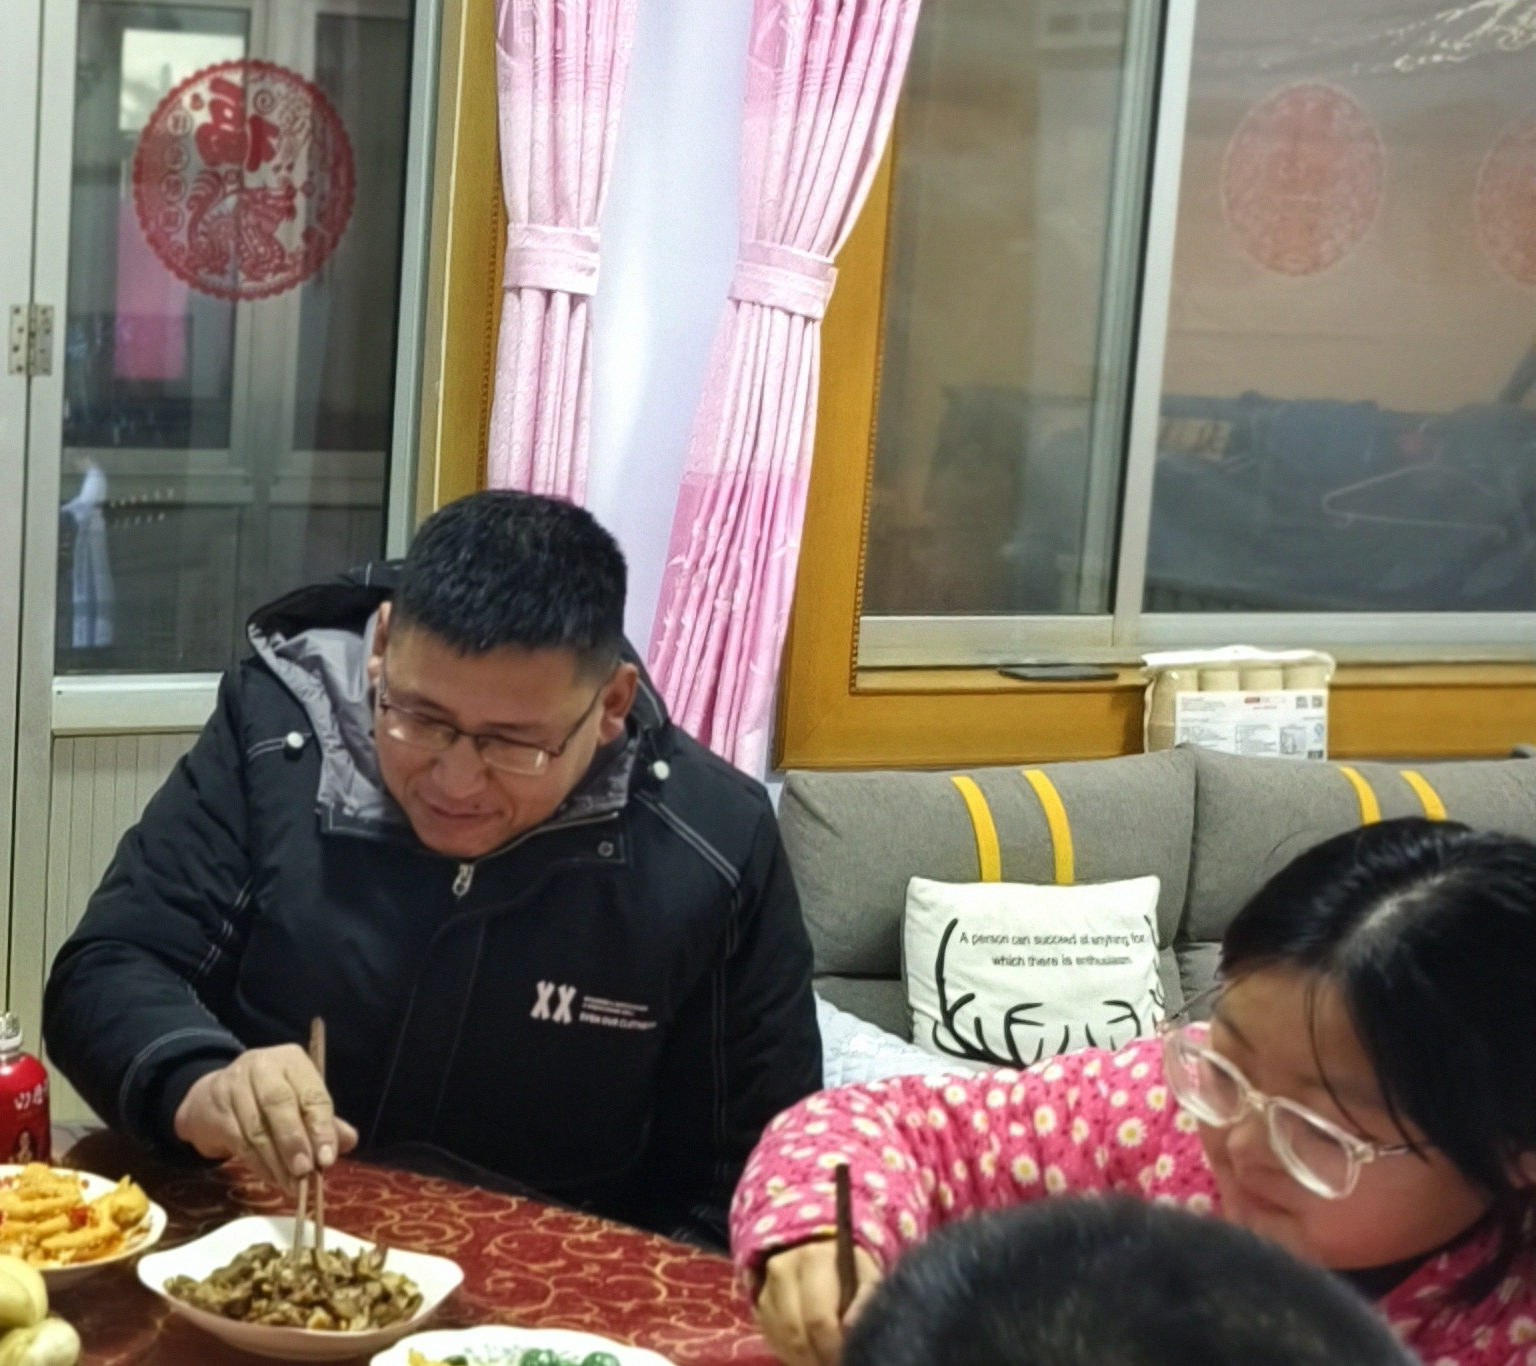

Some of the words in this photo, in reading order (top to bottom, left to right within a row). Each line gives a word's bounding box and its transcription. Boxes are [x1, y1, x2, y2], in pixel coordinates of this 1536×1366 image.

[959, 932, 969, 944] A
[972, 934, 1009, 946] person
[1011, 934, 1031, 945] can
[991, 954, 1025, 966] which
[1028, 954, 1058, 966] there
[1062, 953, 1072, 965] is
